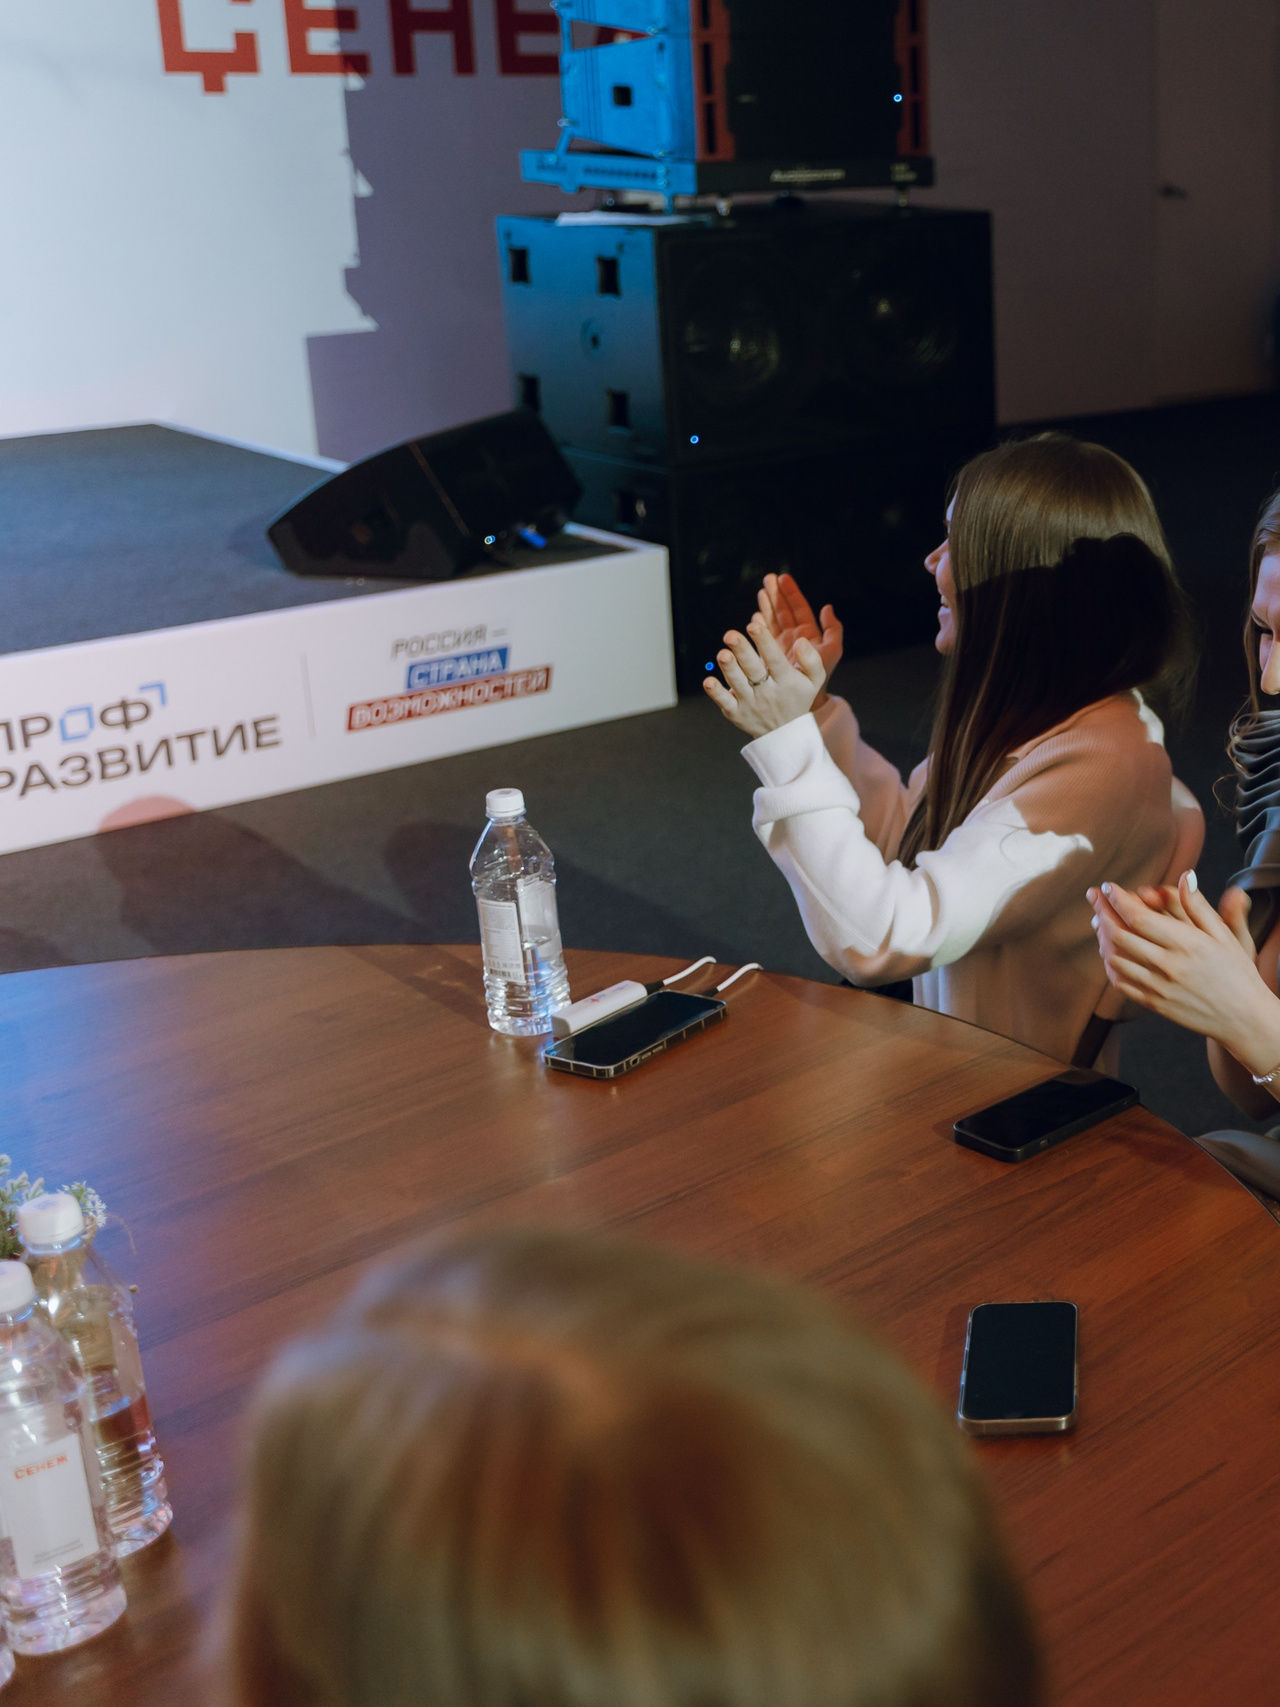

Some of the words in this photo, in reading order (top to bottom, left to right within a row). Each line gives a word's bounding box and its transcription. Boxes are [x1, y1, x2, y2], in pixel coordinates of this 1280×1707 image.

[157, 0, 655, 93] СЕНЕ
[391, 624, 487, 660] РОССИЯ
[409, 649, 503, 689] СТРАНА
[351, 667, 548, 729] ВОЗМОЖНОСТЕЙ
